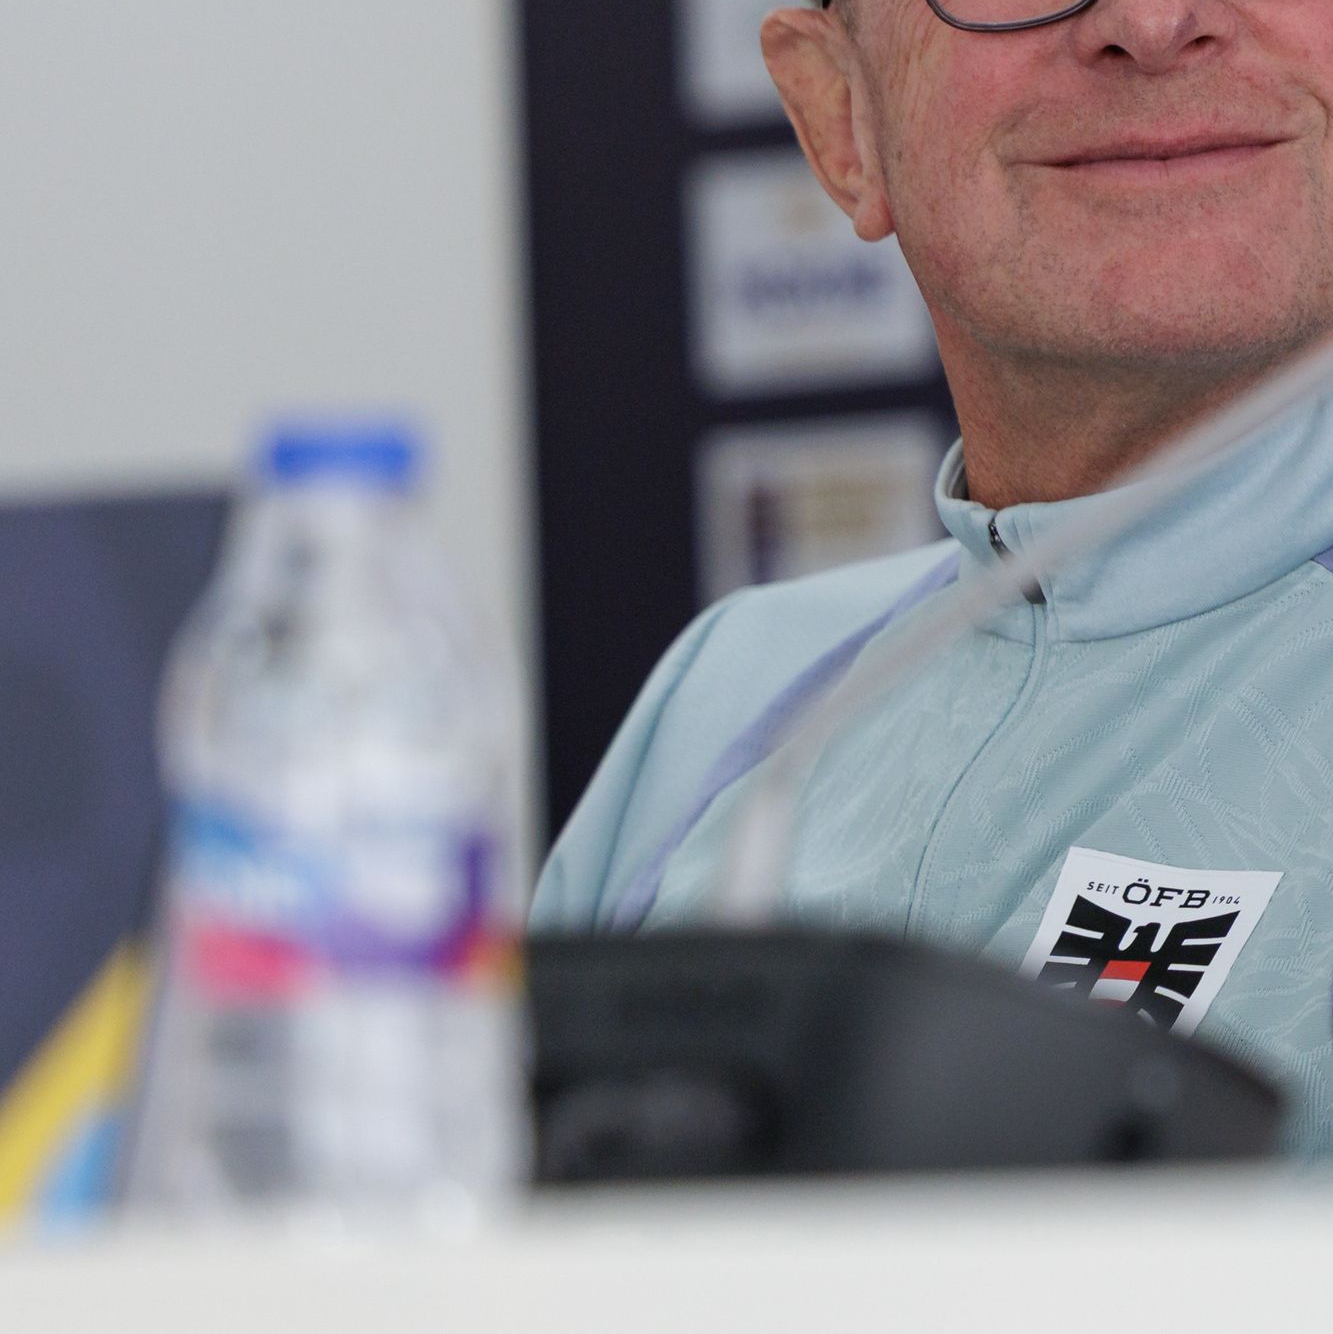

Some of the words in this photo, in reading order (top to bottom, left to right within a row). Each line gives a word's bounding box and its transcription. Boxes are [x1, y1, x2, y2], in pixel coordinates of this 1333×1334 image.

[1086, 881, 1120, 895] SEIT
[1122, 878, 1211, 909] ÖFB
[1212, 896, 1241, 905] 1904
